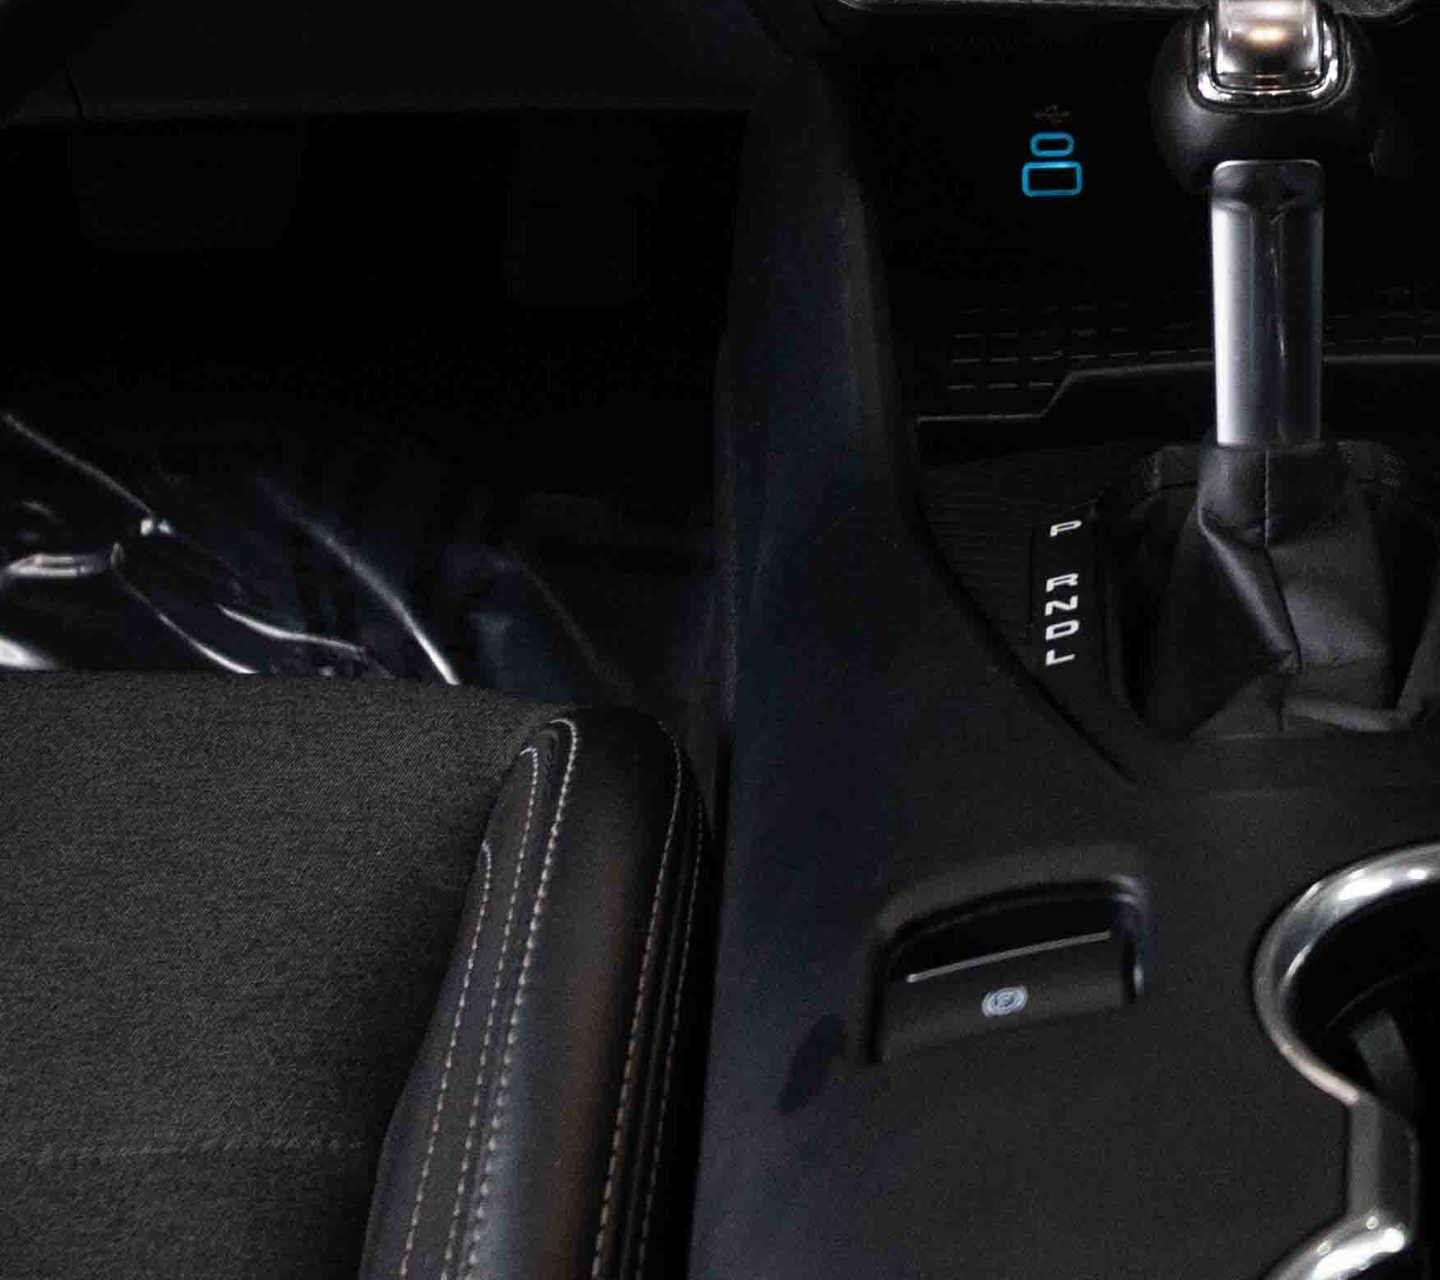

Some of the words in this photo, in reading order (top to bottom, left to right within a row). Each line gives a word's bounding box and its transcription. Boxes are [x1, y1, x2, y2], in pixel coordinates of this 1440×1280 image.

[1049, 520, 1082, 537] P
[1045, 573, 1079, 593] R
[1045, 595, 1079, 616] N
[1045, 619, 1080, 641] D
[1045, 649, 1076, 666] L
